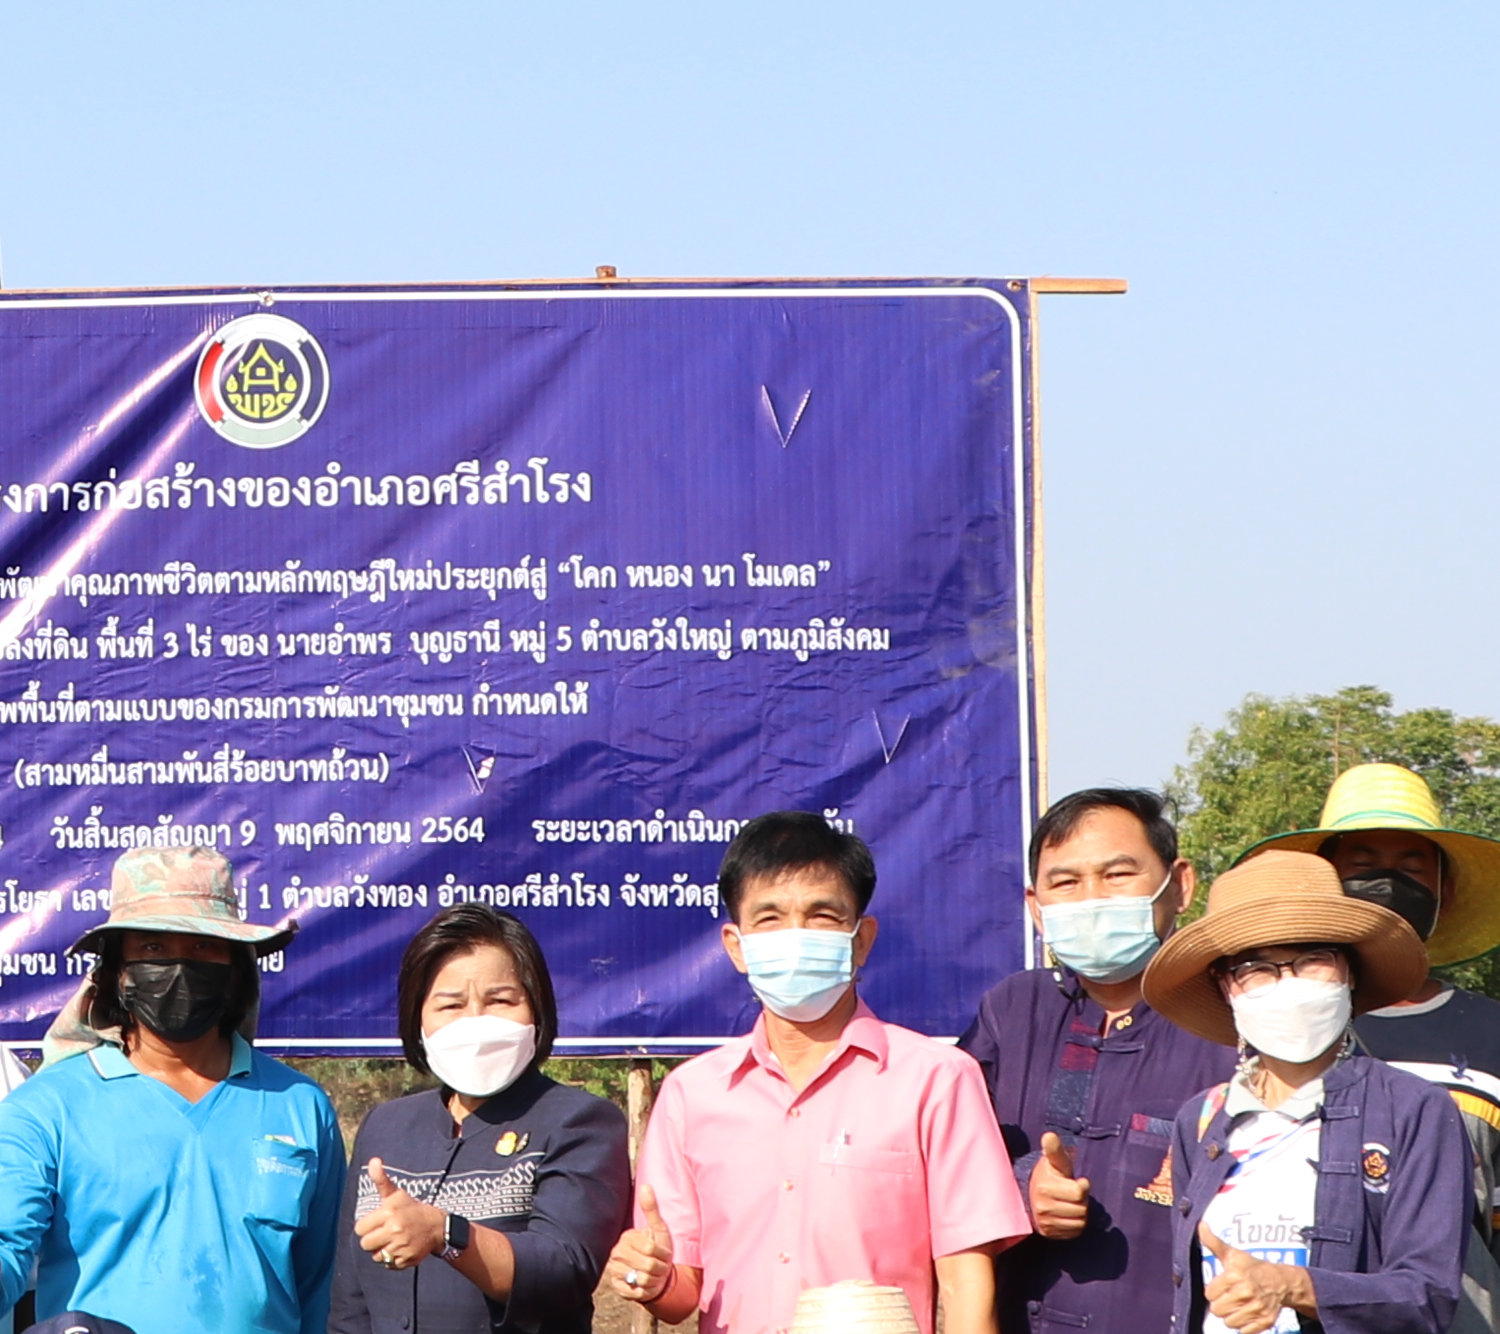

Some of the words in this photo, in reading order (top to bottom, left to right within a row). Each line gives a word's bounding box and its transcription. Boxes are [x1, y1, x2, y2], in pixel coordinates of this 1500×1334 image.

[625, 564, 693, 588] หนอง
[702, 564, 736, 587] นา
[97, 616, 153, 659] พื้นที่
[162, 631, 180, 659] 3
[186, 623, 212, 658] ไร่
[221, 632, 270, 657] ของ
[276, 622, 392, 656] นายอำพร
[409, 618, 501, 665] บุญธานี
[510, 621, 546, 664] หมู่
[555, 625, 572, 652] 5
[581, 617, 732, 660] ตำบลวังใหญ่
[741, 616, 890, 662] ตามภูมิสังคม
[472, 682, 589, 717] กำหนดให้
[13, 744, 389, 790] (สามหมื่นสามพันสี่ร้อยบาทถ้วน)
[239, 820, 257, 848] 9
[274, 812, 412, 852] พฤศจิกายน
[420, 817, 485, 844] 2564
[258, 884, 271, 909] 1
[282, 876, 428, 910] ตำบลวังทอง
[437, 873, 611, 908] อำเภอศรีสำโรง
[619, 873, 723, 919] จังหวัดสุ
